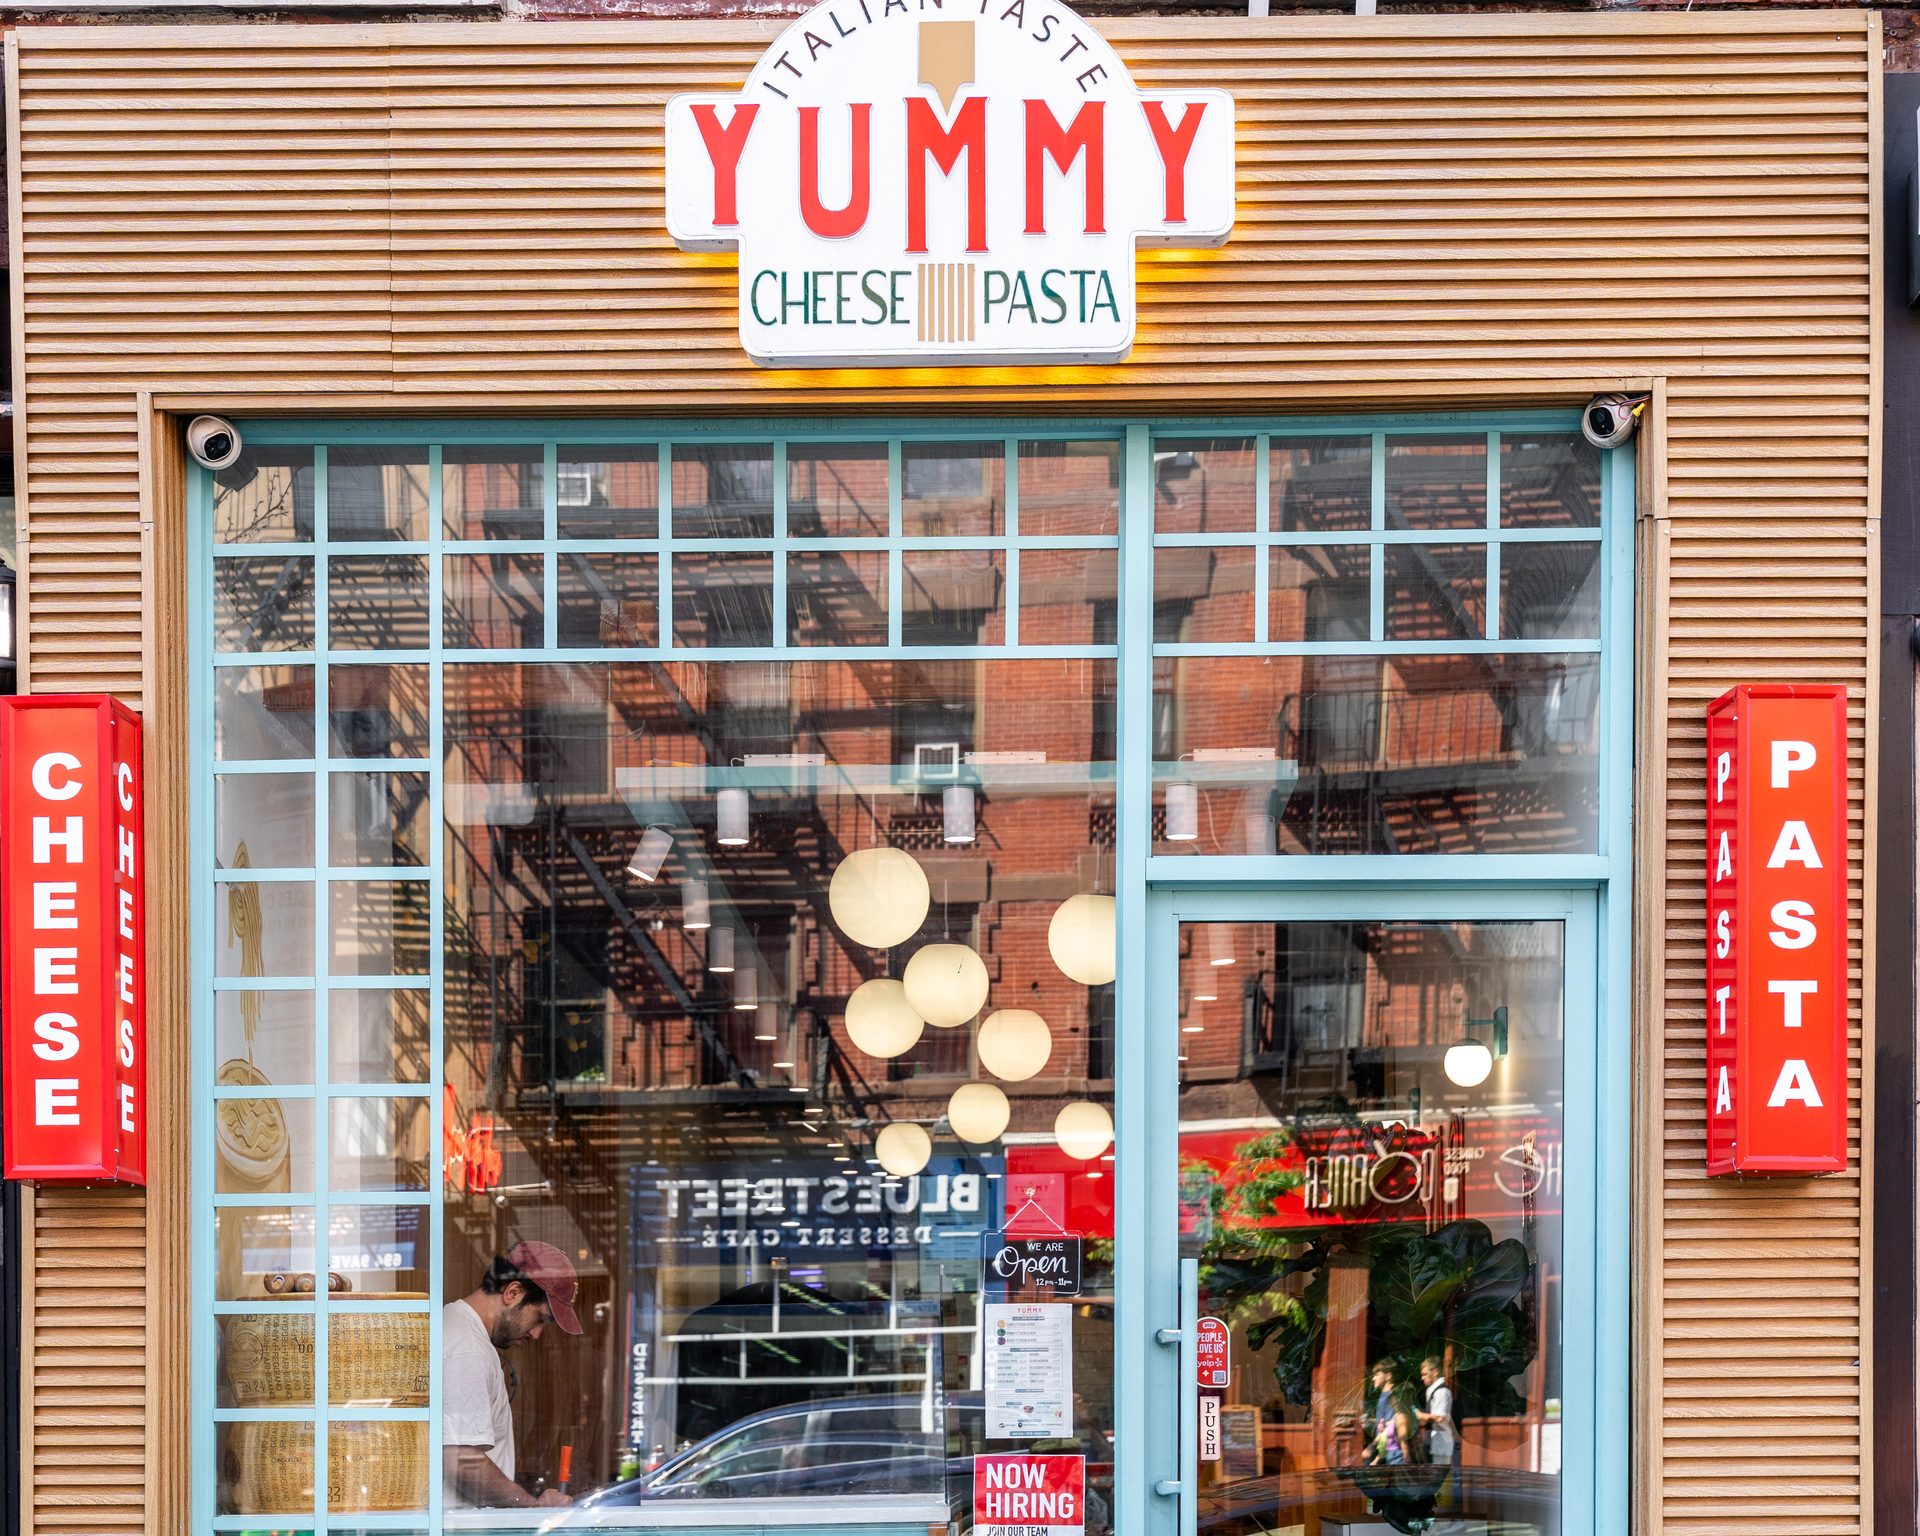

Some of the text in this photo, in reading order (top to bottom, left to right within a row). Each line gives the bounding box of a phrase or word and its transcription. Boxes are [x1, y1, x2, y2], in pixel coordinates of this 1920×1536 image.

[691, 96, 1208, 254] YUMMY
[750, 269, 1121, 326] CHEESE PASTA
[31, 752, 84, 1126] CHEESE
[1716, 751, 1732, 1116] PASTA
[1766, 740, 1824, 1108] PASTA
[117, 762, 136, 1133] CHEESE
[994, 1246, 1069, 1284] Open
[1027, 1242, 1064, 1252] WE ARE
[1197, 1343, 1223, 1353] OVE US
[1197, 1359, 1214, 1367] yelp
[1205, 1402, 1216, 1455] PUSH
[986, 1463, 1046, 1489] NOW
[986, 1492, 1074, 1519] HIRING
[987, 1526, 1048, 1536] JOIN OUR TEAM
